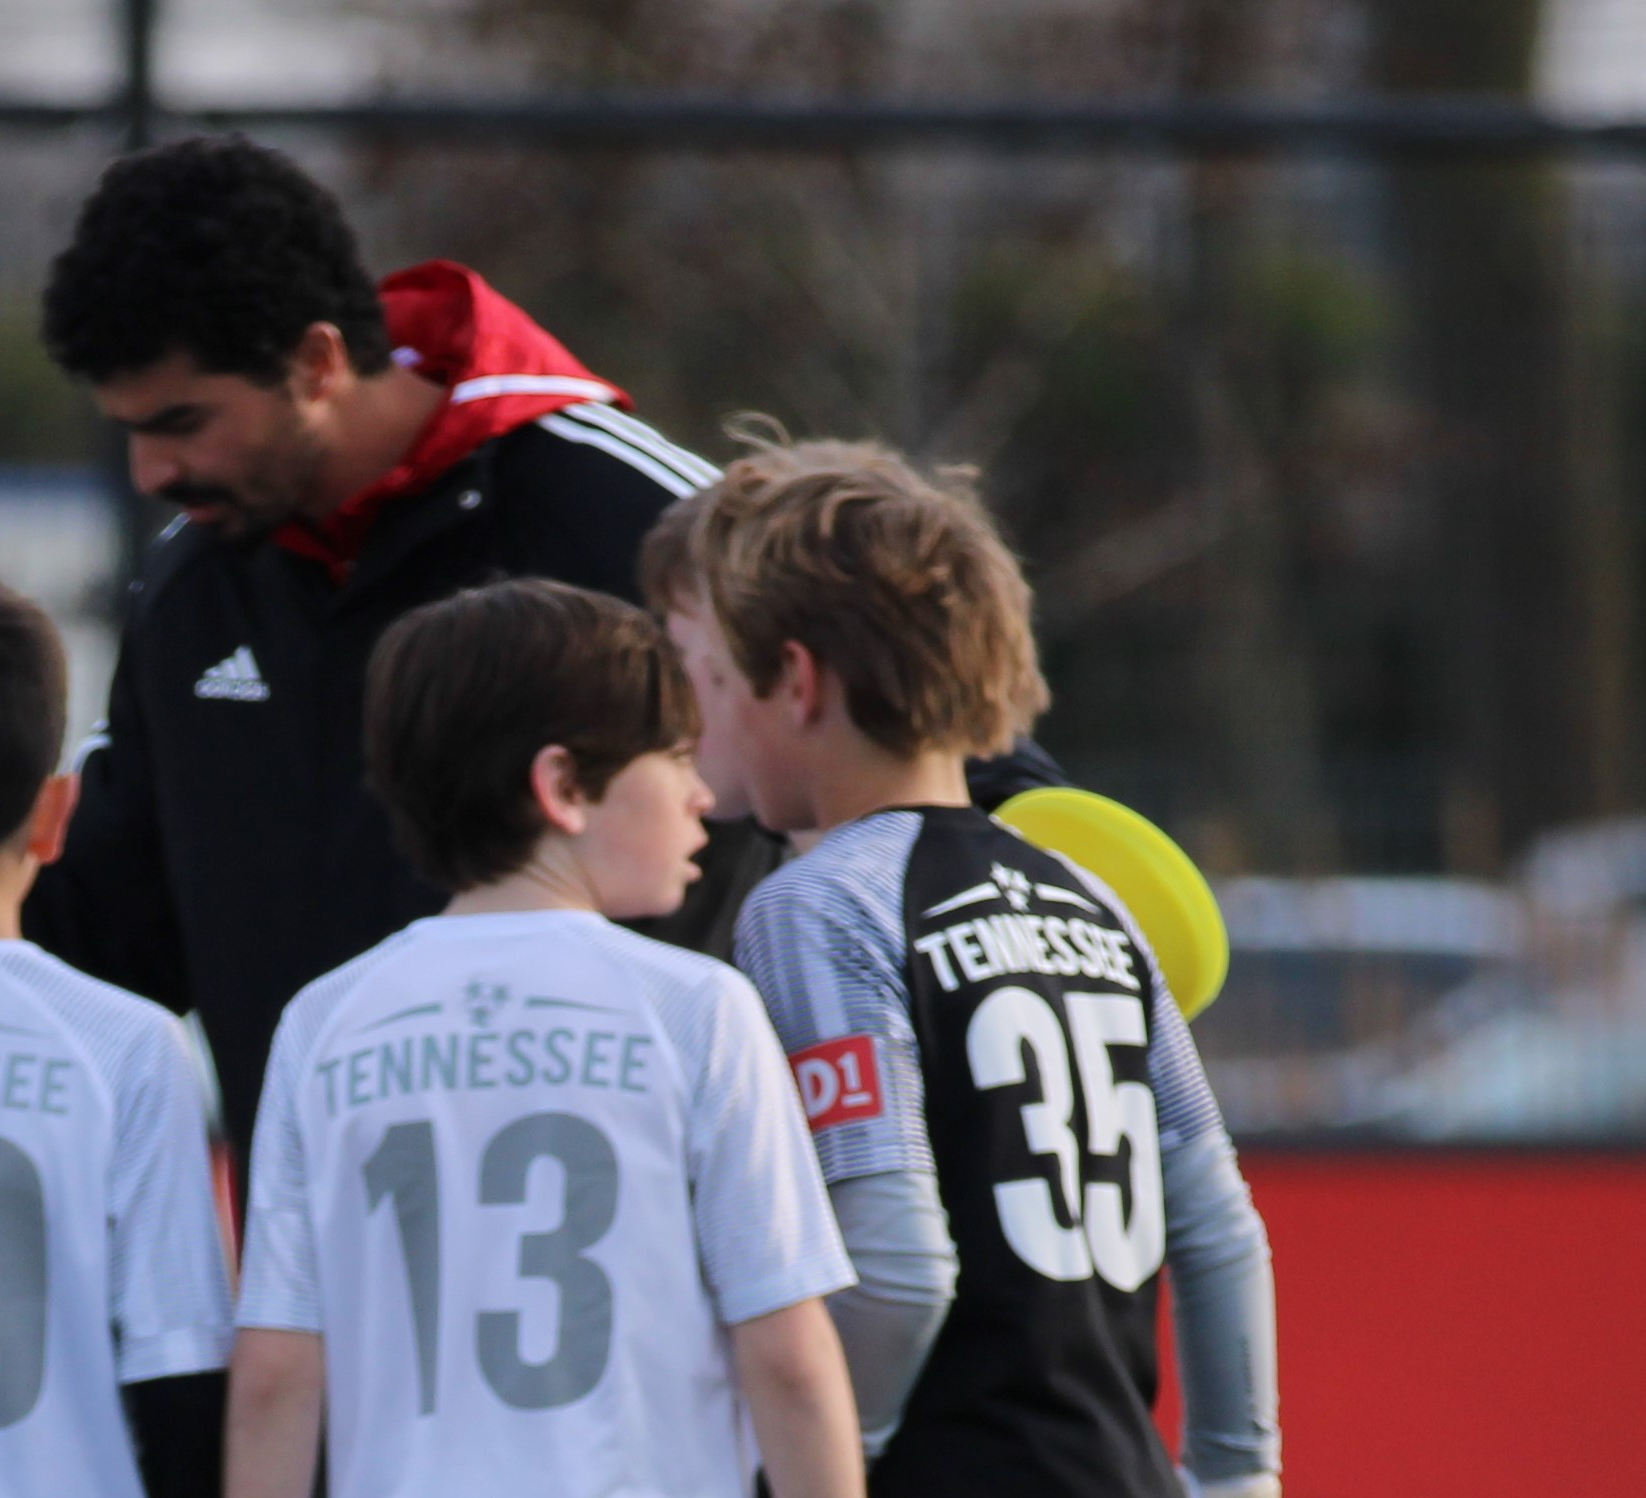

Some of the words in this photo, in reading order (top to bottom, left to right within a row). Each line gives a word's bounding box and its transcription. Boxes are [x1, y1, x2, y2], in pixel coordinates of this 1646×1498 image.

[914, 914, 1141, 992] TENNESSEE
[317, 1028, 653, 1117] TENNESSEE
[796, 1050, 871, 1118] D1
[966, 986, 1166, 1293] 35
[363, 1112, 620, 1417] 13
